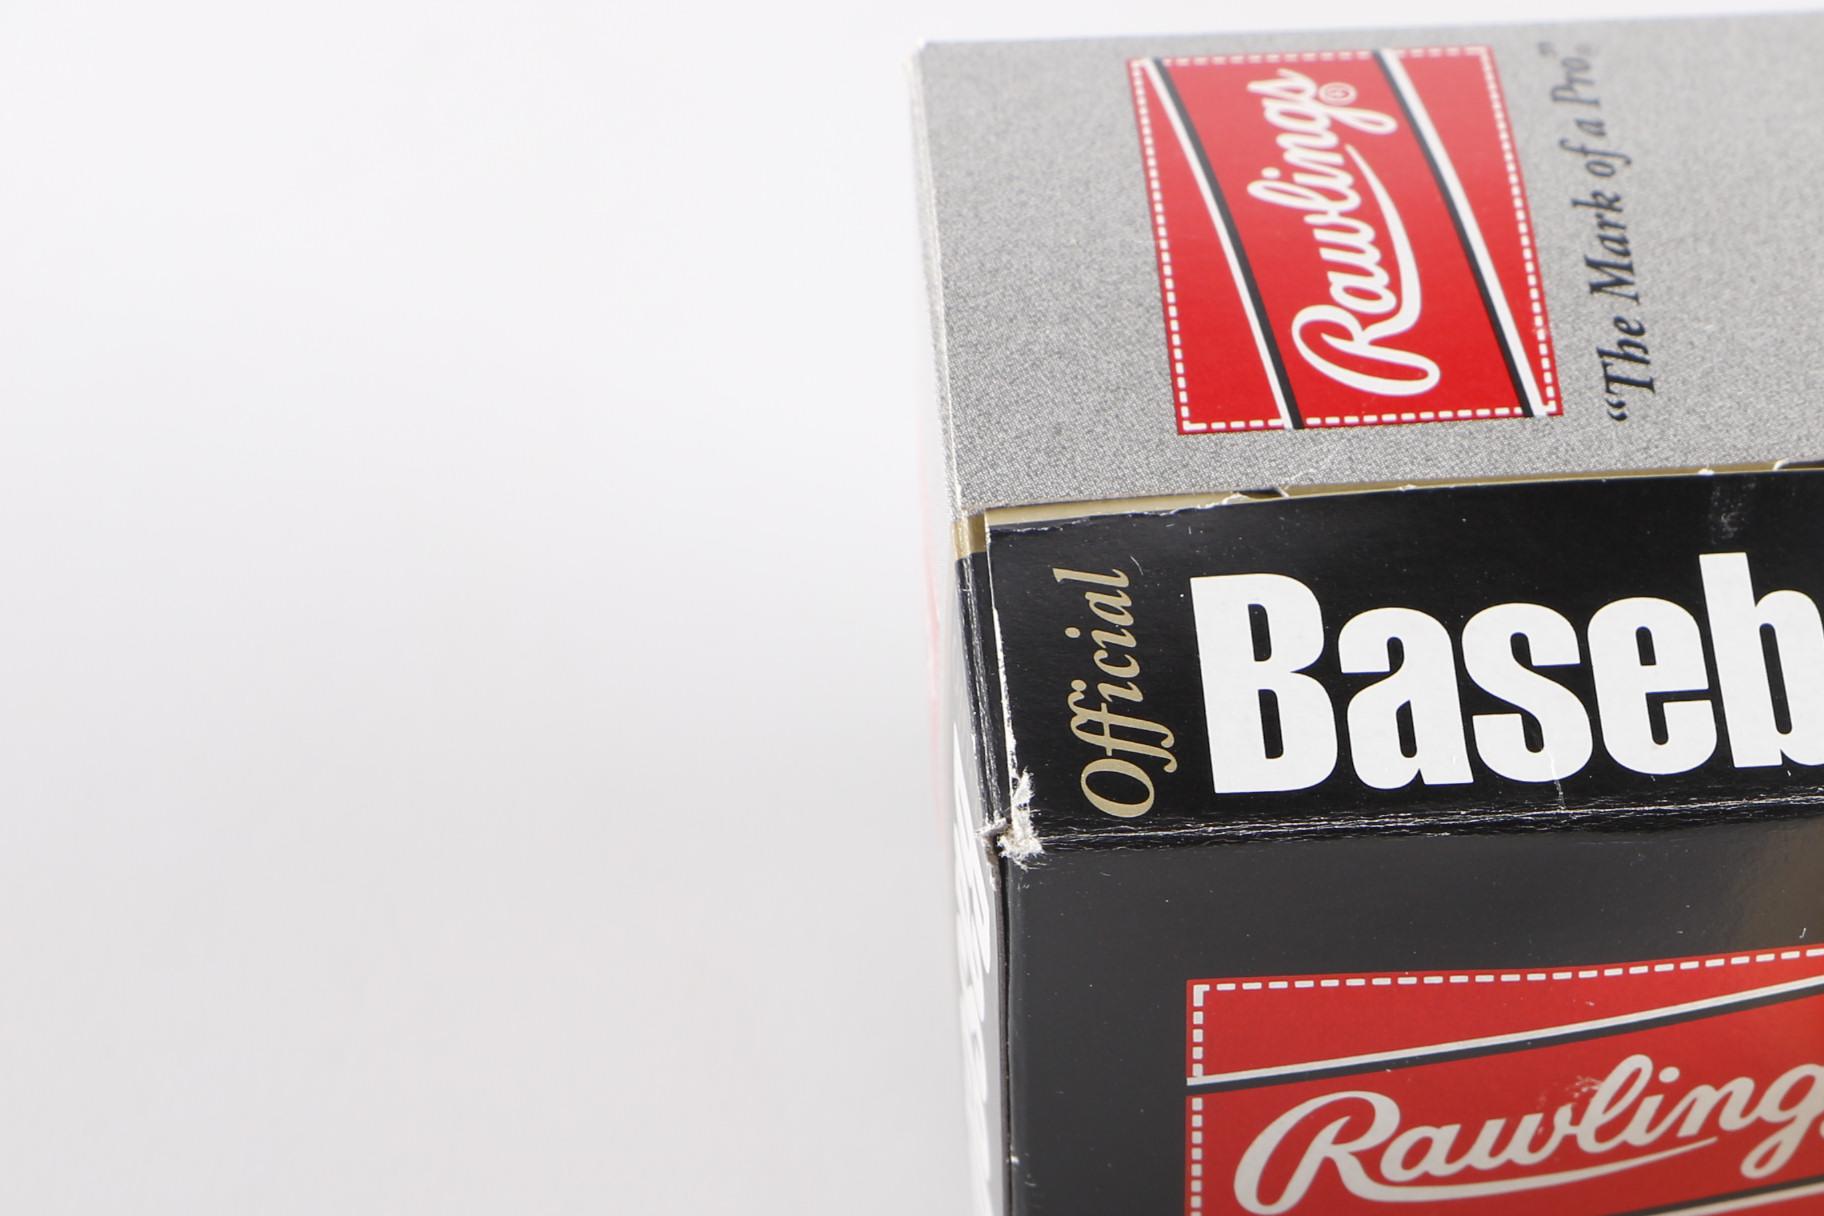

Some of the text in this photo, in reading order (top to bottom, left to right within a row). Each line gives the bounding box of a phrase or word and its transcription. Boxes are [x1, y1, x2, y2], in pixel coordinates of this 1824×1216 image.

[1559, 137, 1632, 178] of
[1574, 117, 1606, 137] a
[1246, 67, 1440, 396] Rawlings
[1570, 189, 1640, 304] Mark
[1052, 567, 1176, 818] Official
